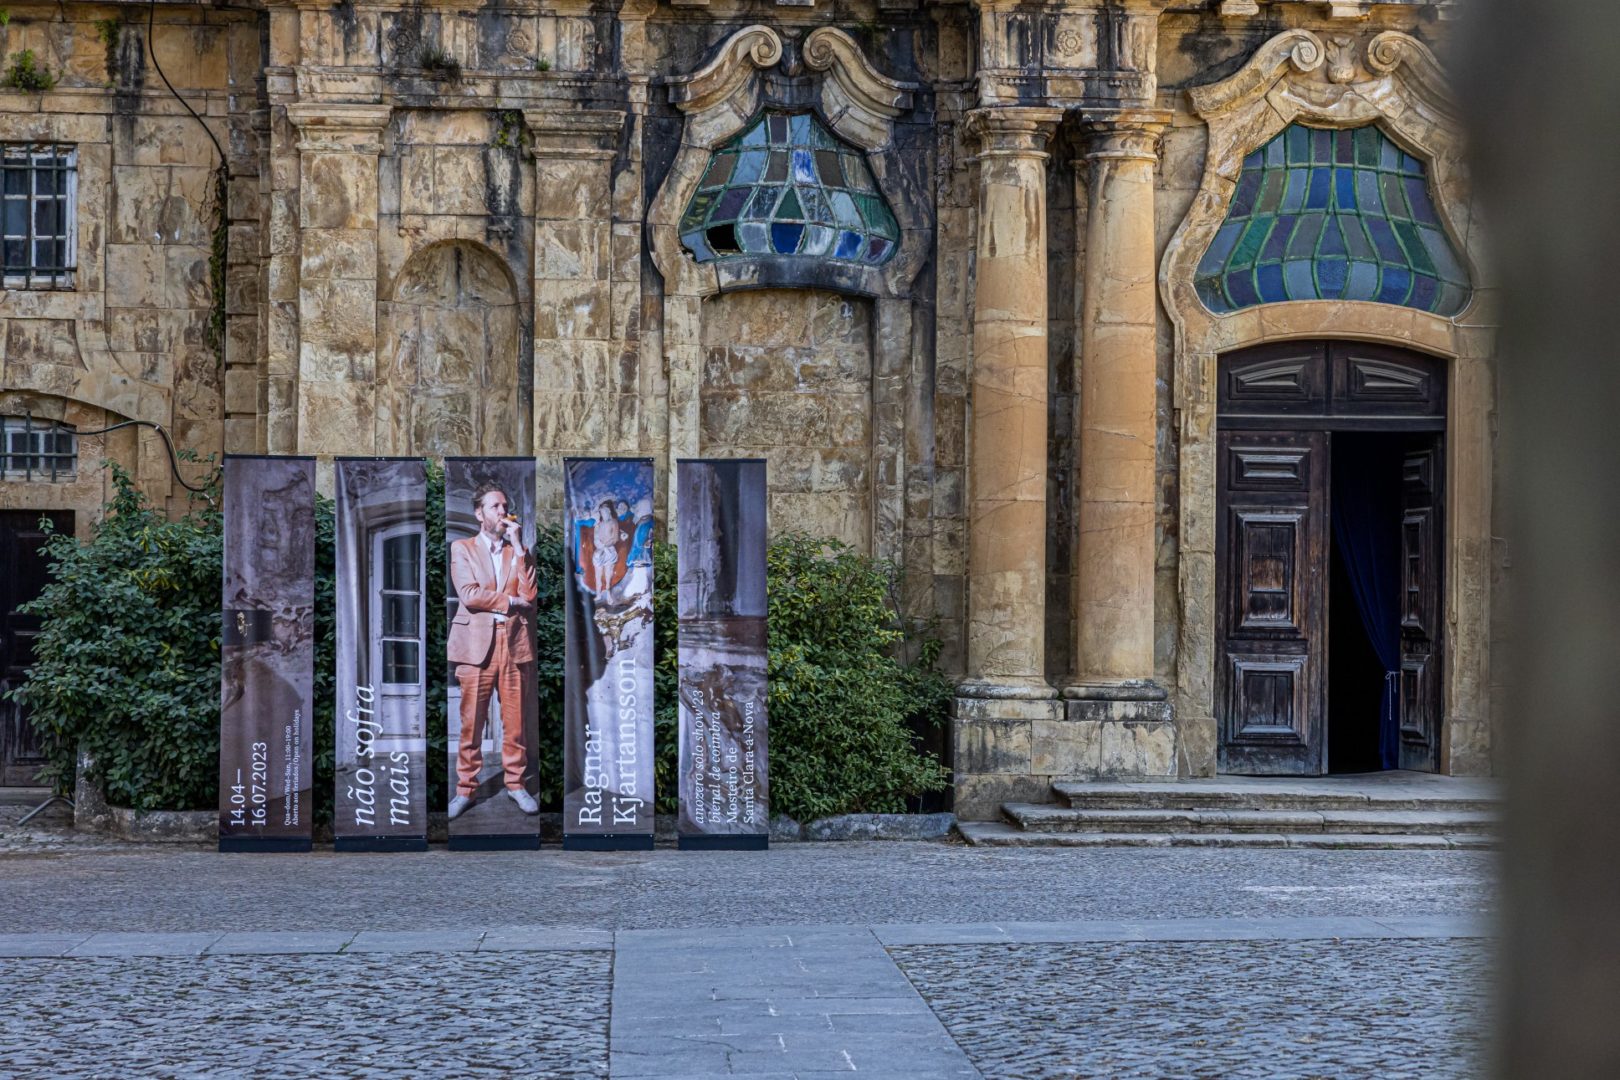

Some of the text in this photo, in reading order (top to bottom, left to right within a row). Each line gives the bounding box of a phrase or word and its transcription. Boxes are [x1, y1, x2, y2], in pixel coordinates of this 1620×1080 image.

[252, 742, 266, 826] 16.07.2023
[347, 684, 383, 825] não sofra
[579, 724, 609, 825] Ragnar
[612, 658, 643, 825] Kjartansson
[692, 745, 704, 769] solo
[709, 712, 720, 822] bienal de coimbra
[726, 748, 737, 823] Mosteiro de
[743, 702, 754, 823] Santa Clara-a-Nova
[380, 752, 410, 825] mais
[694, 773, 704, 823] anozero
